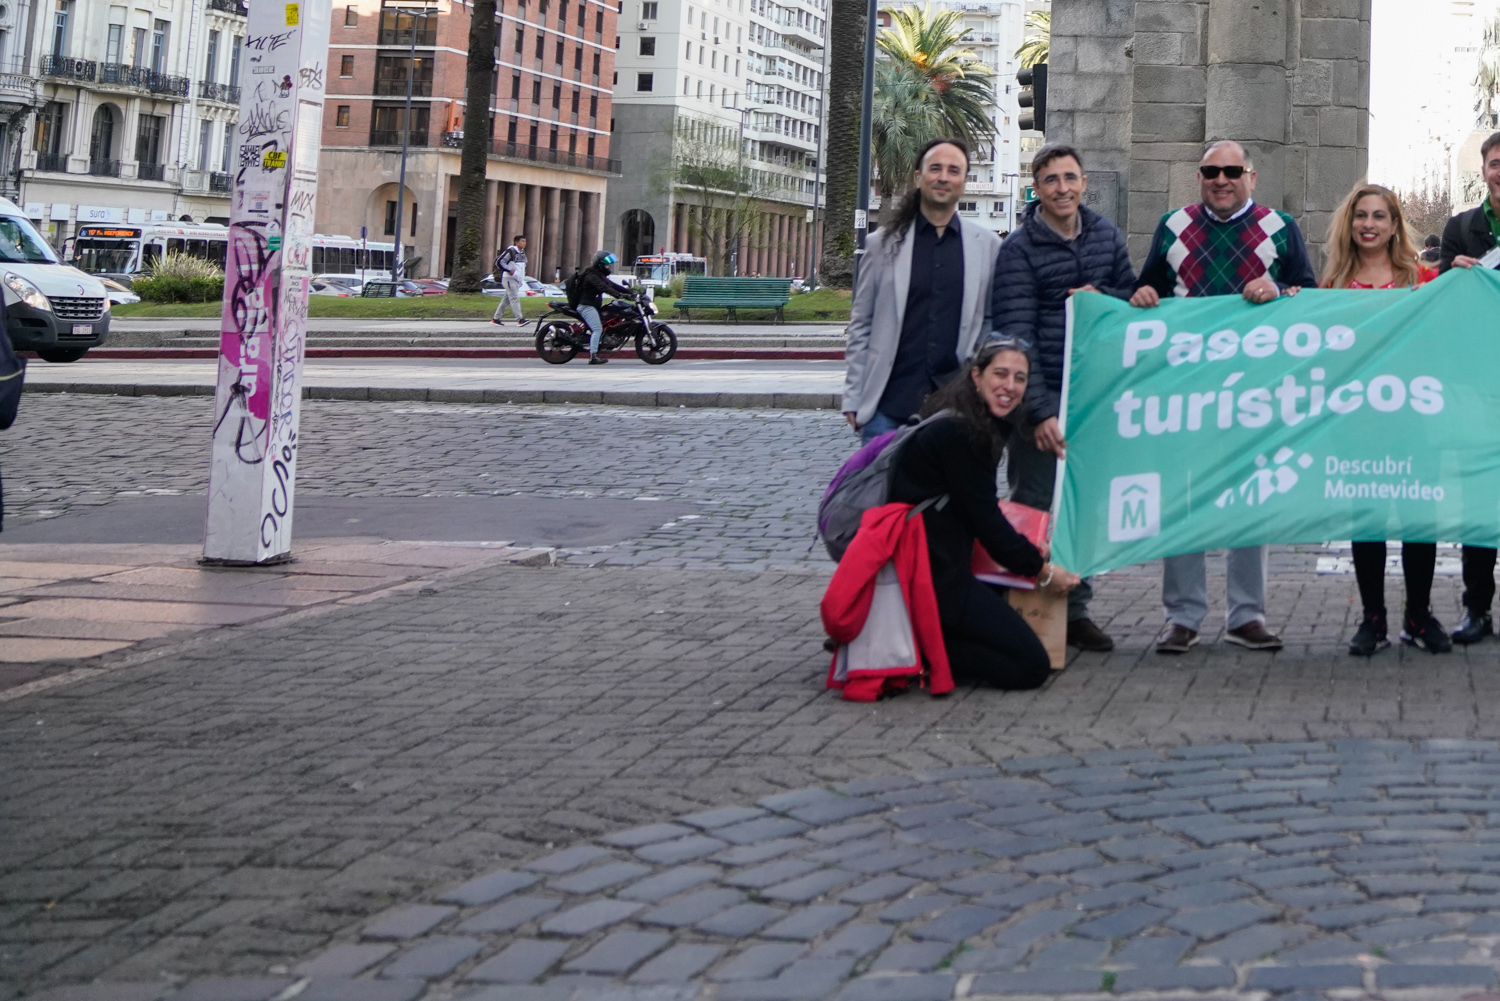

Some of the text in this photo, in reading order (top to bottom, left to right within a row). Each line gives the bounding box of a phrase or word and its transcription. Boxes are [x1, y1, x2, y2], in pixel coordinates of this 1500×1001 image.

[90, 209, 105, 219] sura
[1113, 367, 1445, 439] turísticos
[1325, 455, 1412, 476] Descubrí
[1324, 479, 1445, 502] Montevideo
